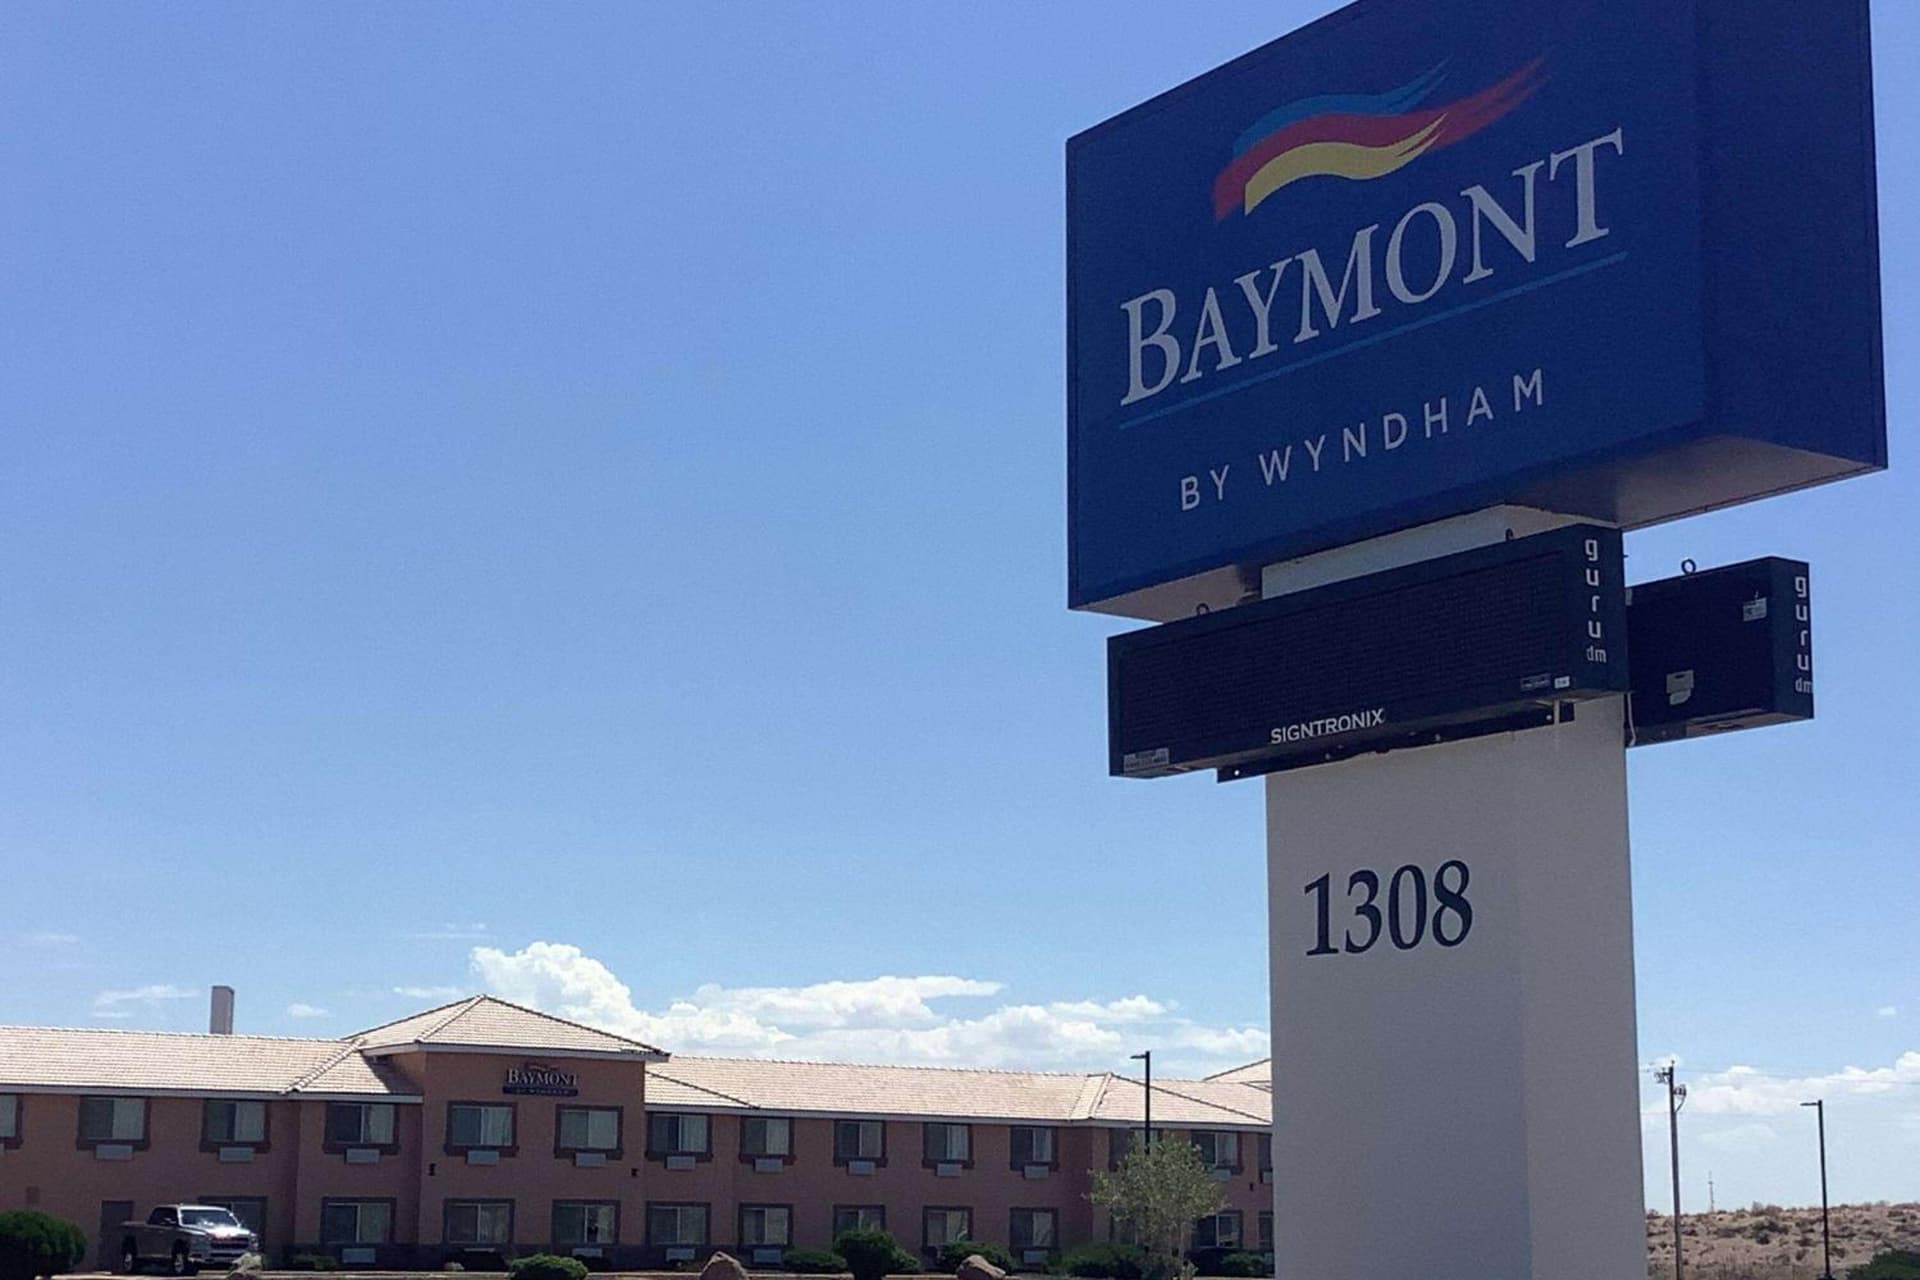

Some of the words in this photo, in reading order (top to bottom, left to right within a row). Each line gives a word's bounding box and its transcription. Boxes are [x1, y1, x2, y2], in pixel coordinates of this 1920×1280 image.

[1119, 128, 1623, 406] BAYMONT
[1180, 464, 1230, 512] BY
[1258, 367, 1544, 486] WYNDHAM
[1586, 645, 1607, 664] dm
[1270, 707, 1385, 745] SIGNTRONIX
[1304, 859, 1473, 956] 1308
[506, 1067, 578, 1087] BAYMONT
